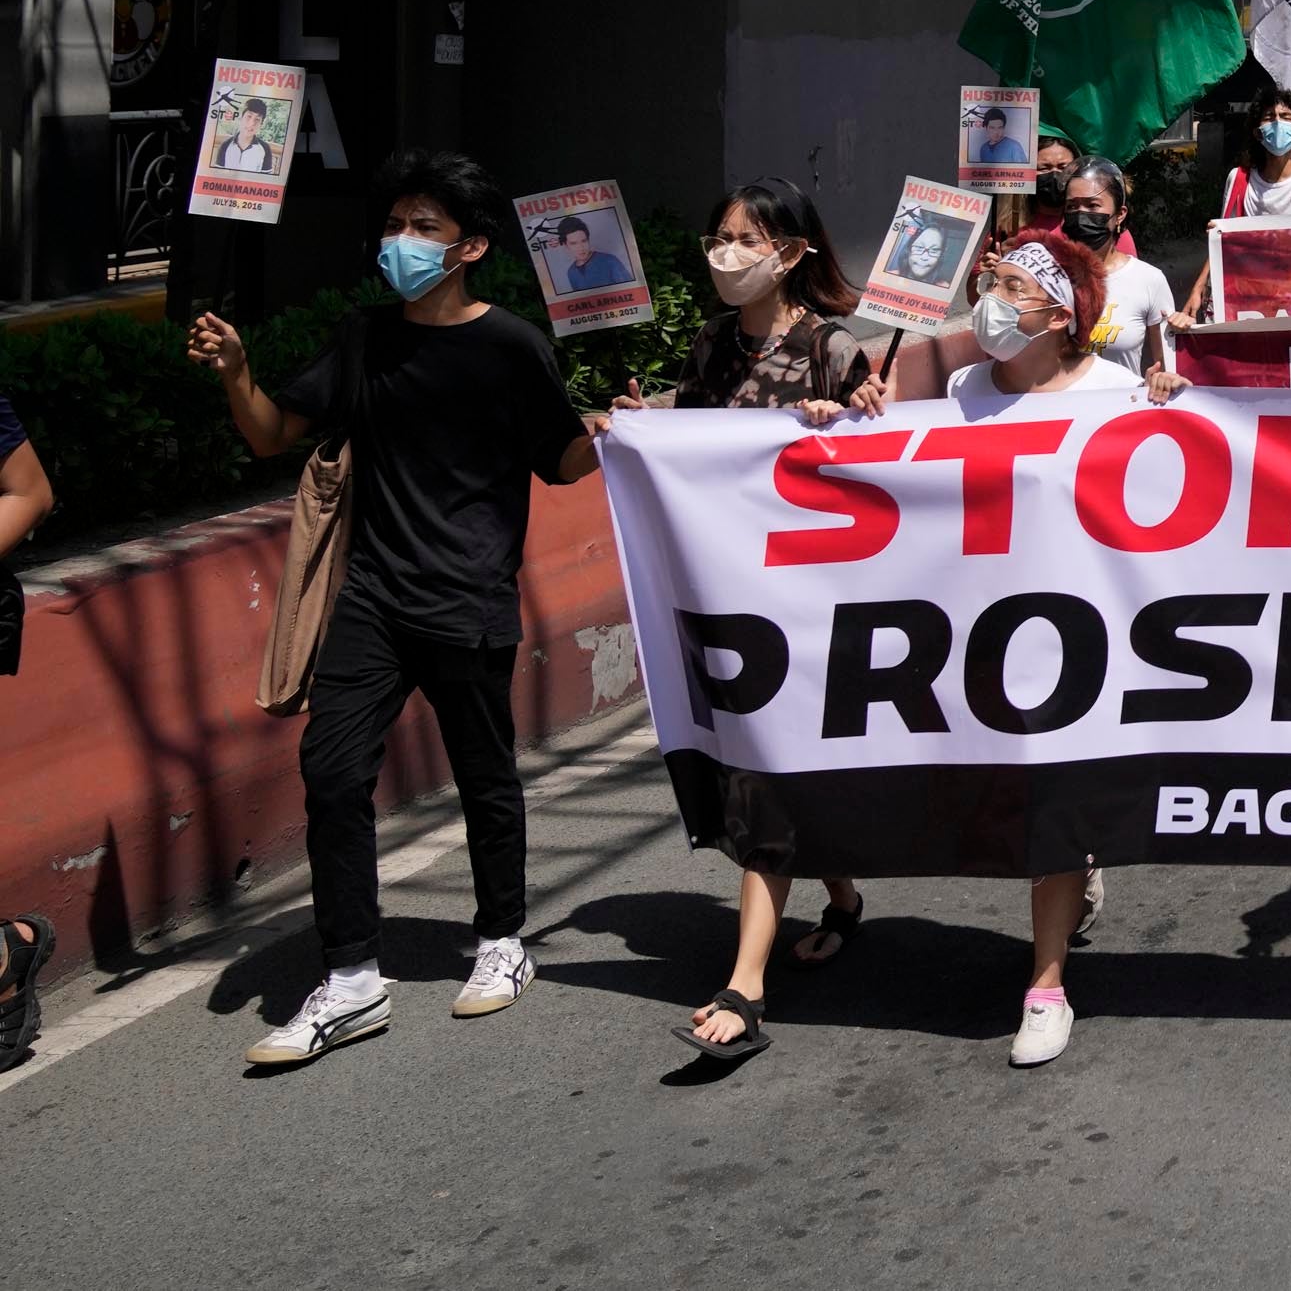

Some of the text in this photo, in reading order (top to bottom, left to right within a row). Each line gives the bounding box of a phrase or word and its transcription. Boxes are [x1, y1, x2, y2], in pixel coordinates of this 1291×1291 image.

[217, 66, 302, 90] HUSTISYA!
[963, 89, 1037, 103] HUSTISYA!
[971, 170, 1025, 179] CARL ARNAIZ
[202, 181, 279, 199] ROMAN MANAOIS
[905, 182, 989, 216] HUSTISYA!
[212, 197, 227, 207] JULY
[241, 200, 263, 211] 2016
[518, 184, 618, 218] HUSTISYA!
[567, 293, 634, 313] CARL ARNAIZ
[865, 287, 905, 305] KRISTINE
[905, 297, 921, 308] JOY
[569, 307, 639, 327] AUGUST 18, 2017
[867, 302, 938, 327] DECEMBER 22, 2016
